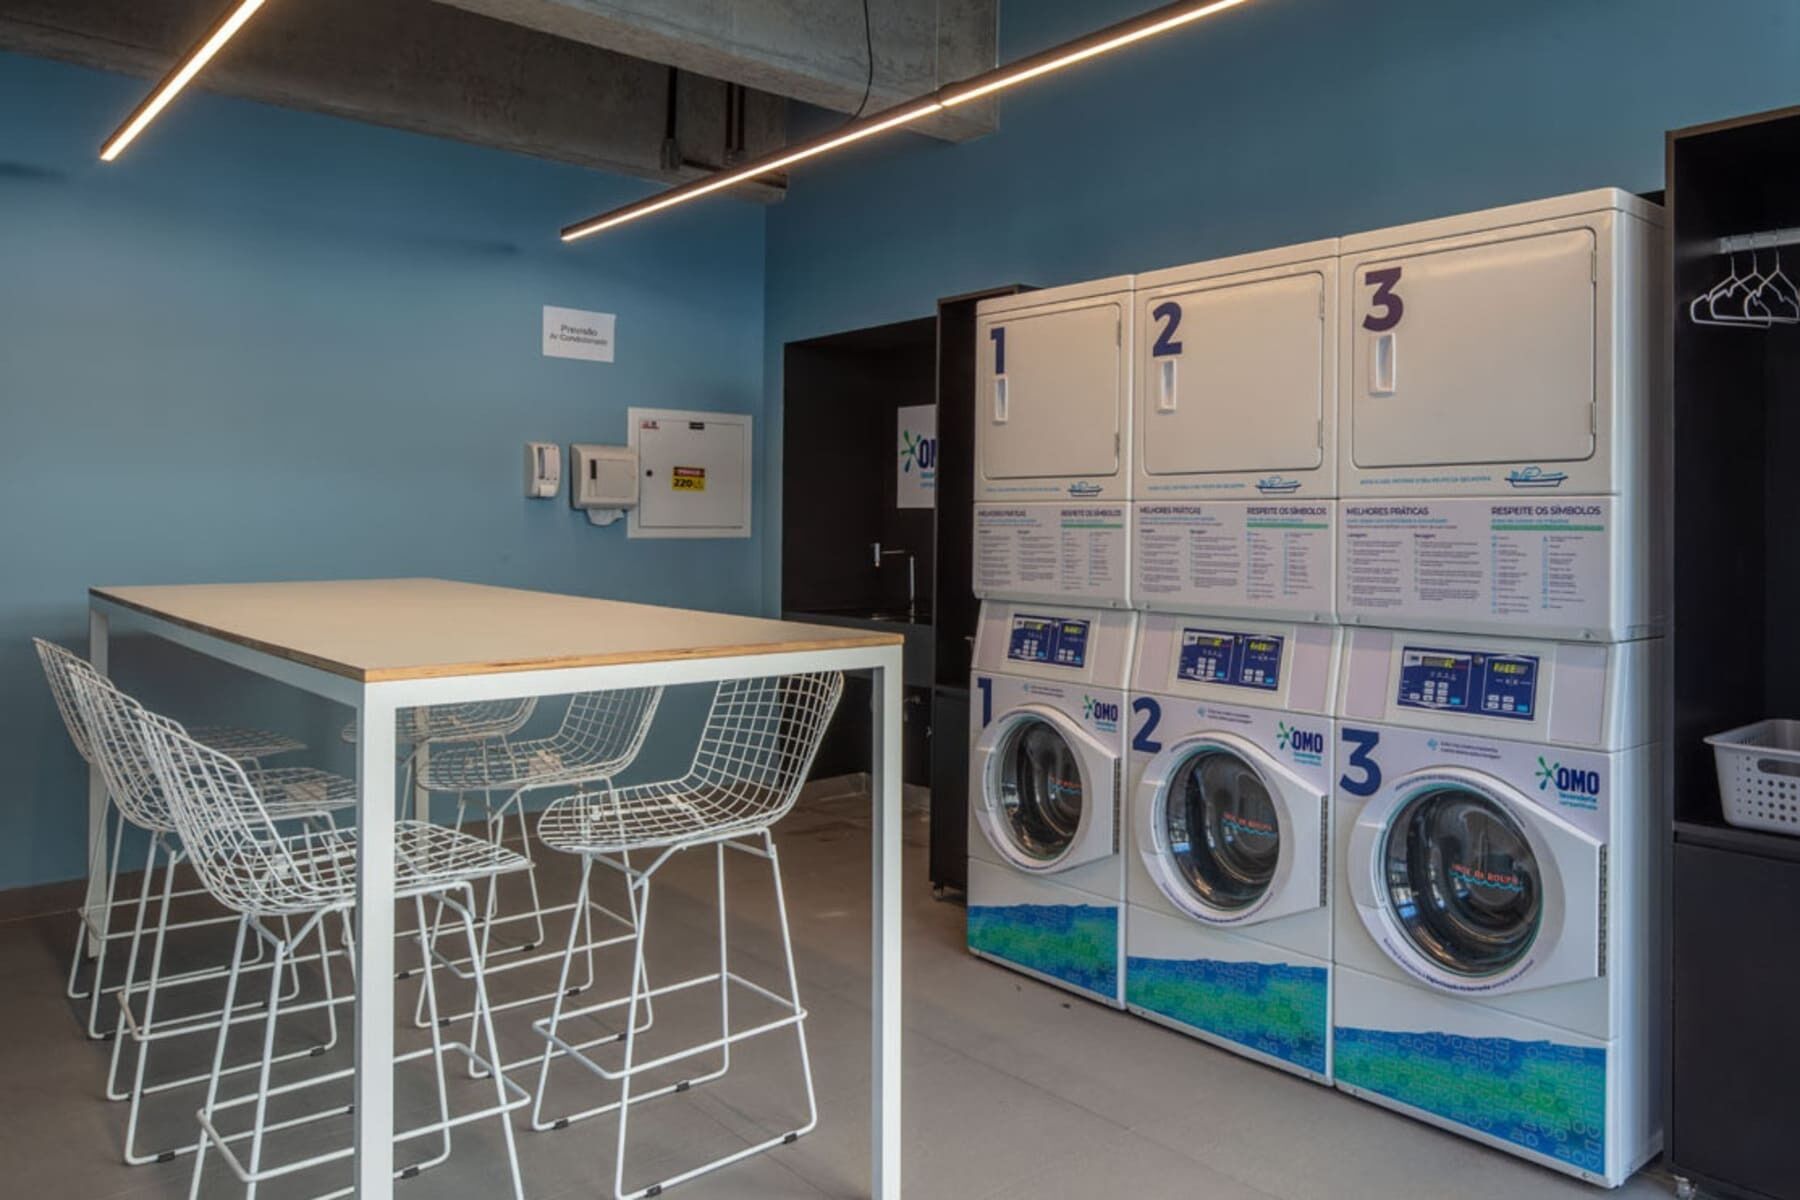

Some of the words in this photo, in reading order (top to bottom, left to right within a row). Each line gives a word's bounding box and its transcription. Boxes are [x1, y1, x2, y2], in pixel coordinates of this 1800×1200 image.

[1363, 266, 1404, 332] 3
[560, 323, 599, 337] Previsão
[1152, 302, 1183, 357] 2
[990, 327, 1006, 375] 1
[1139, 506, 1171, 515] MELHORES
[1246, 506, 1277, 516] RESPEITE
[1345, 506, 1389, 516] MELHORES
[1390, 505, 1429, 516] PRÁTICAS
[1491, 506, 1532, 516] RESPEITE
[1535, 506, 1549, 516] OS
[1550, 504, 1601, 516] SÍMBOLOS
[977, 677, 992, 728] 1
[1094, 702, 1119, 722] OMO
[1132, 696, 1162, 753] 2
[1292, 730, 1324, 753] OMO
[1339, 727, 1382, 797] 3
[1556, 766, 1601, 796] OMO
